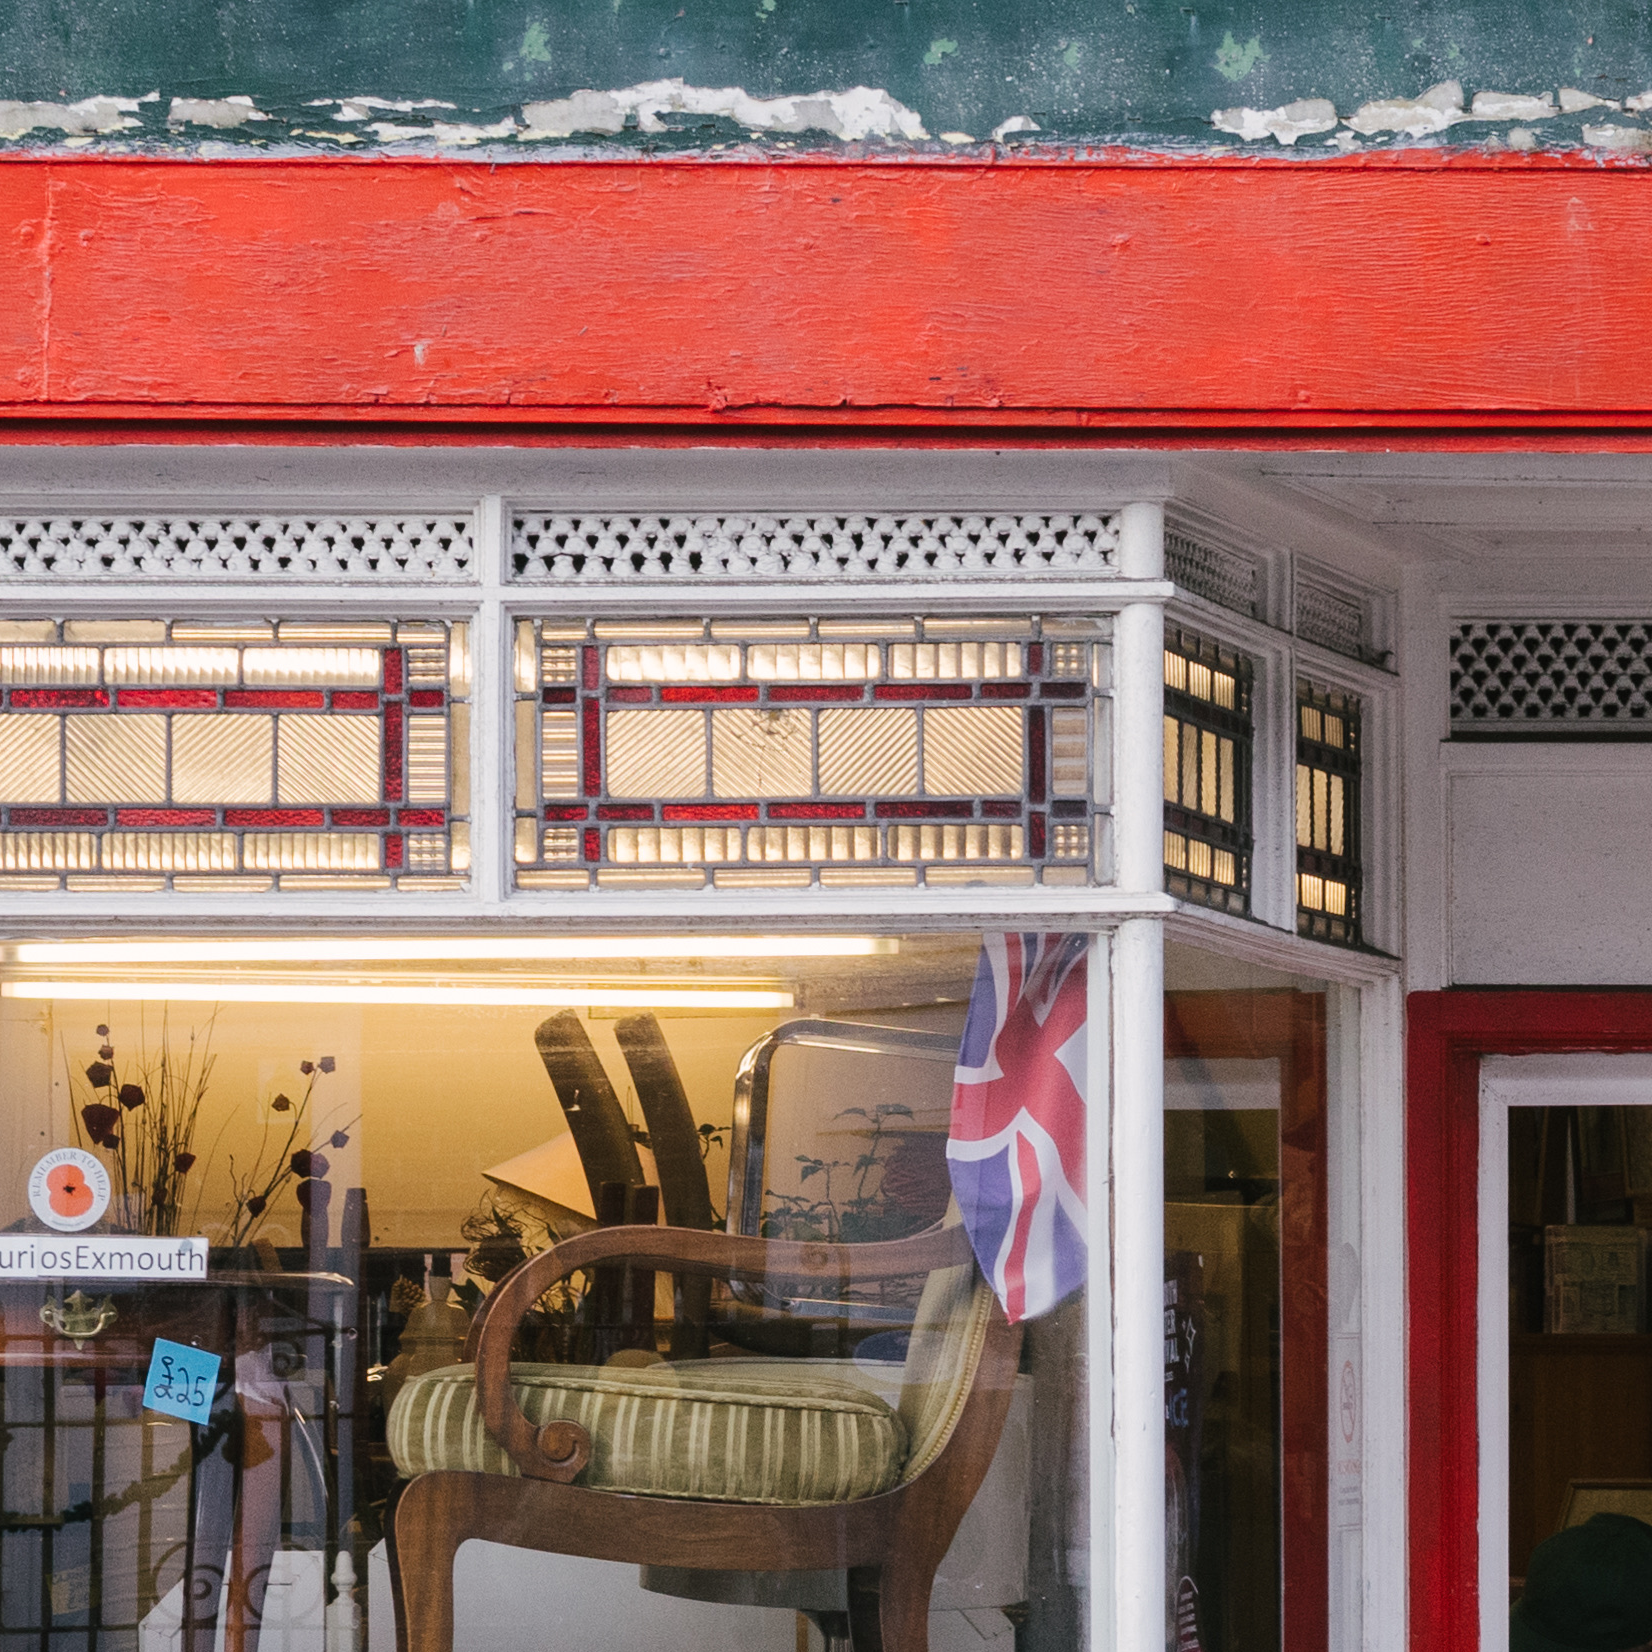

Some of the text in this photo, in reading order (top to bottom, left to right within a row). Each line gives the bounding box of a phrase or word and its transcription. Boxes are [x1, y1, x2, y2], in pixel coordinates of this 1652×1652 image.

[33, 1151, 107, 1201] REMEMBER TO HELP
